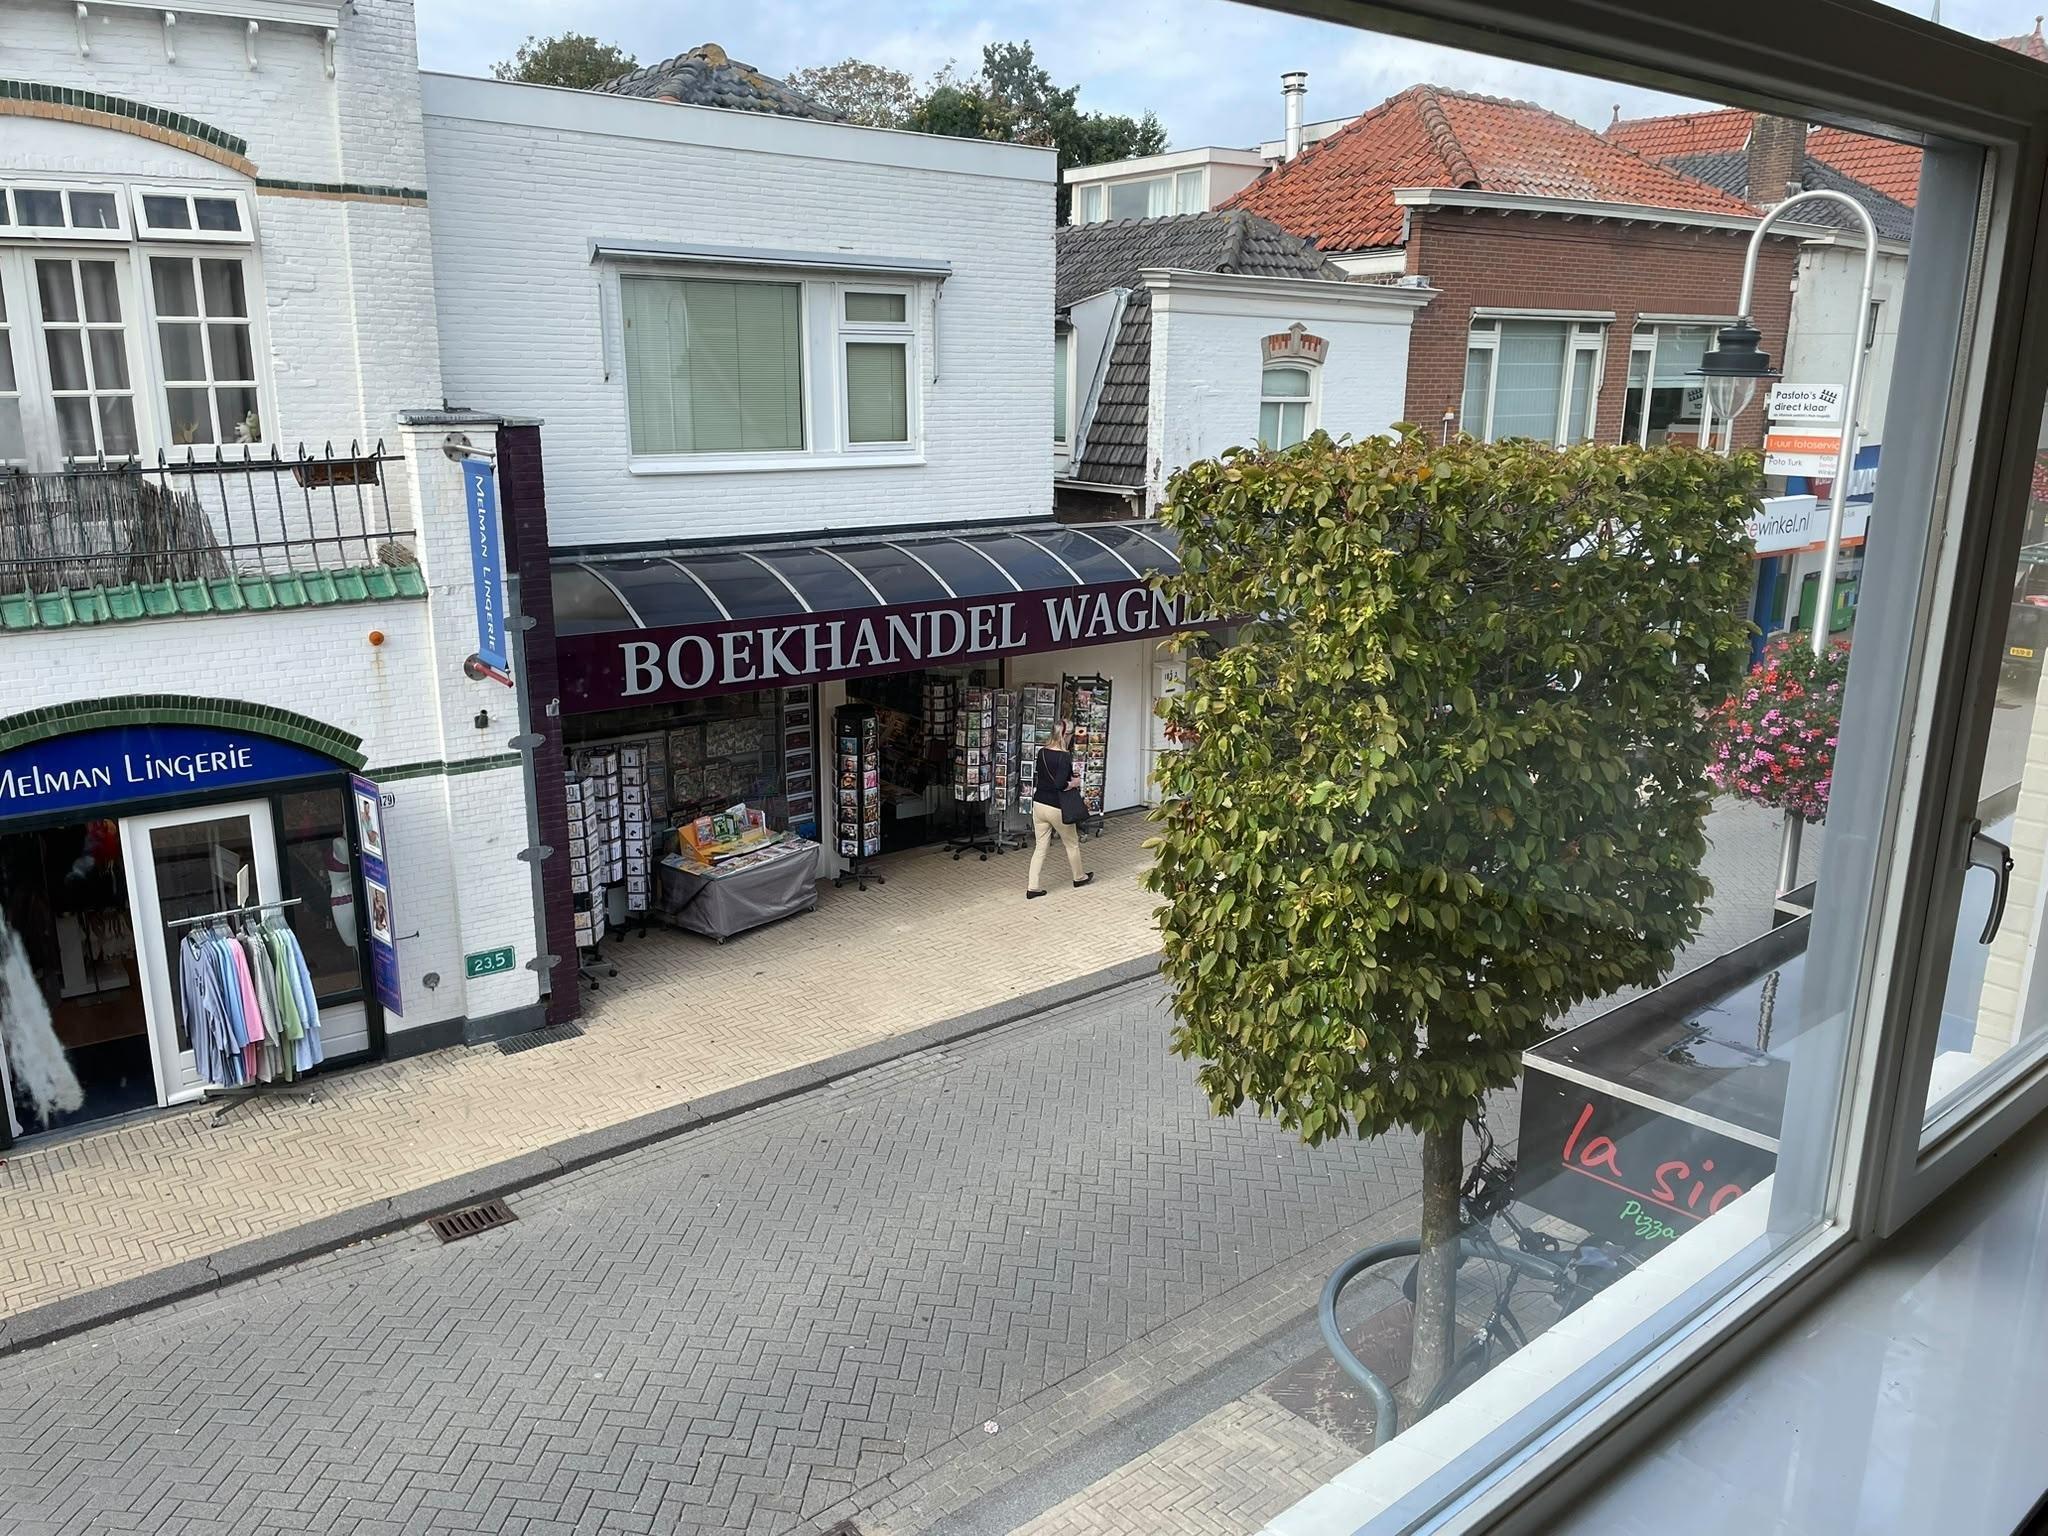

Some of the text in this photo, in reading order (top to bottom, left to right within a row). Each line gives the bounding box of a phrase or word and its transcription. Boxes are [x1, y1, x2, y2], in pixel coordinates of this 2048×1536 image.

[1776, 391, 1817, 400] Pasfoto's
[1774, 402, 1828, 412] direct klaar
[1793, 439, 1840, 450] fotoservic
[1769, 458, 1786, 466] Foto
[618, 581, 1220, 697] BOEKHANDEL WAGN
[1562, 1102, 1622, 1177] la
[1618, 1199, 1680, 1240] Pizza
